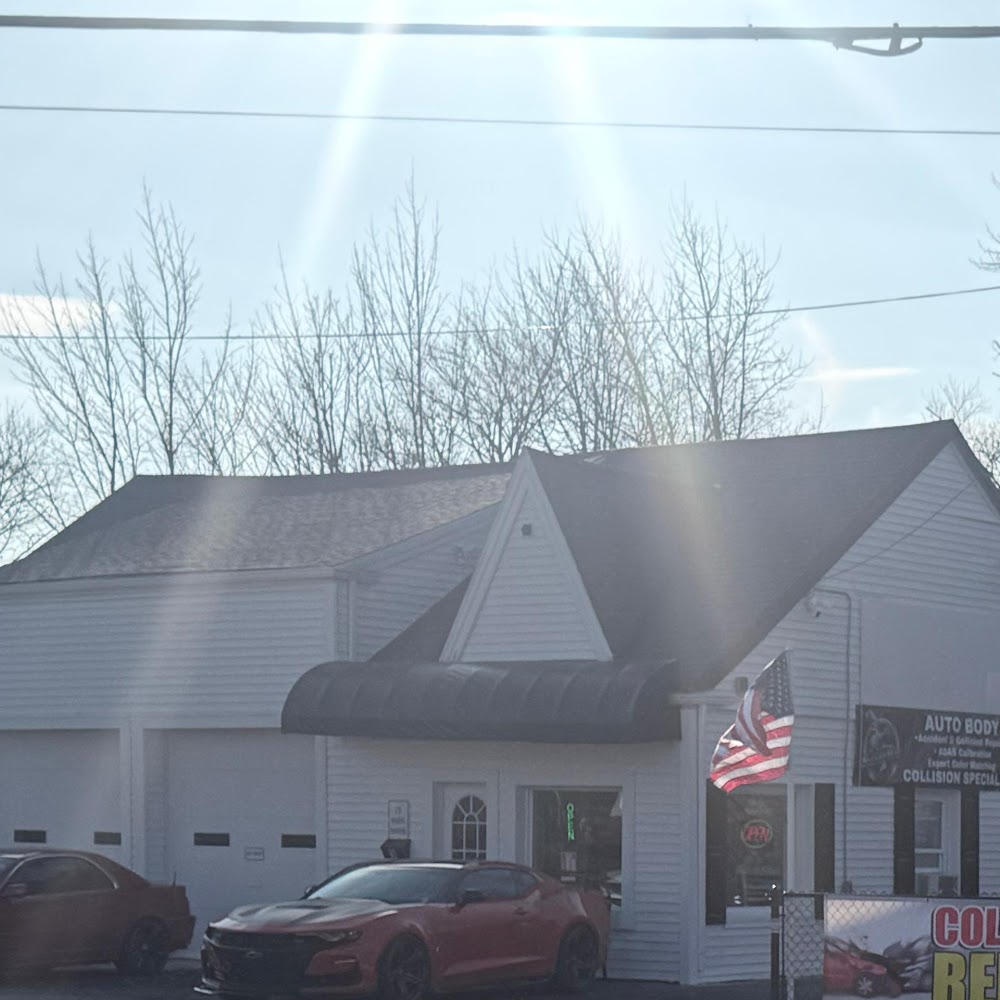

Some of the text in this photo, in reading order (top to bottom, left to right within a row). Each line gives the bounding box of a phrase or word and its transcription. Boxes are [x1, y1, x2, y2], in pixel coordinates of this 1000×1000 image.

[924, 714, 999, 736] AUTO BODY
[902, 769, 961, 785] COLLISION
[566, 802, 575, 842] OPEN
